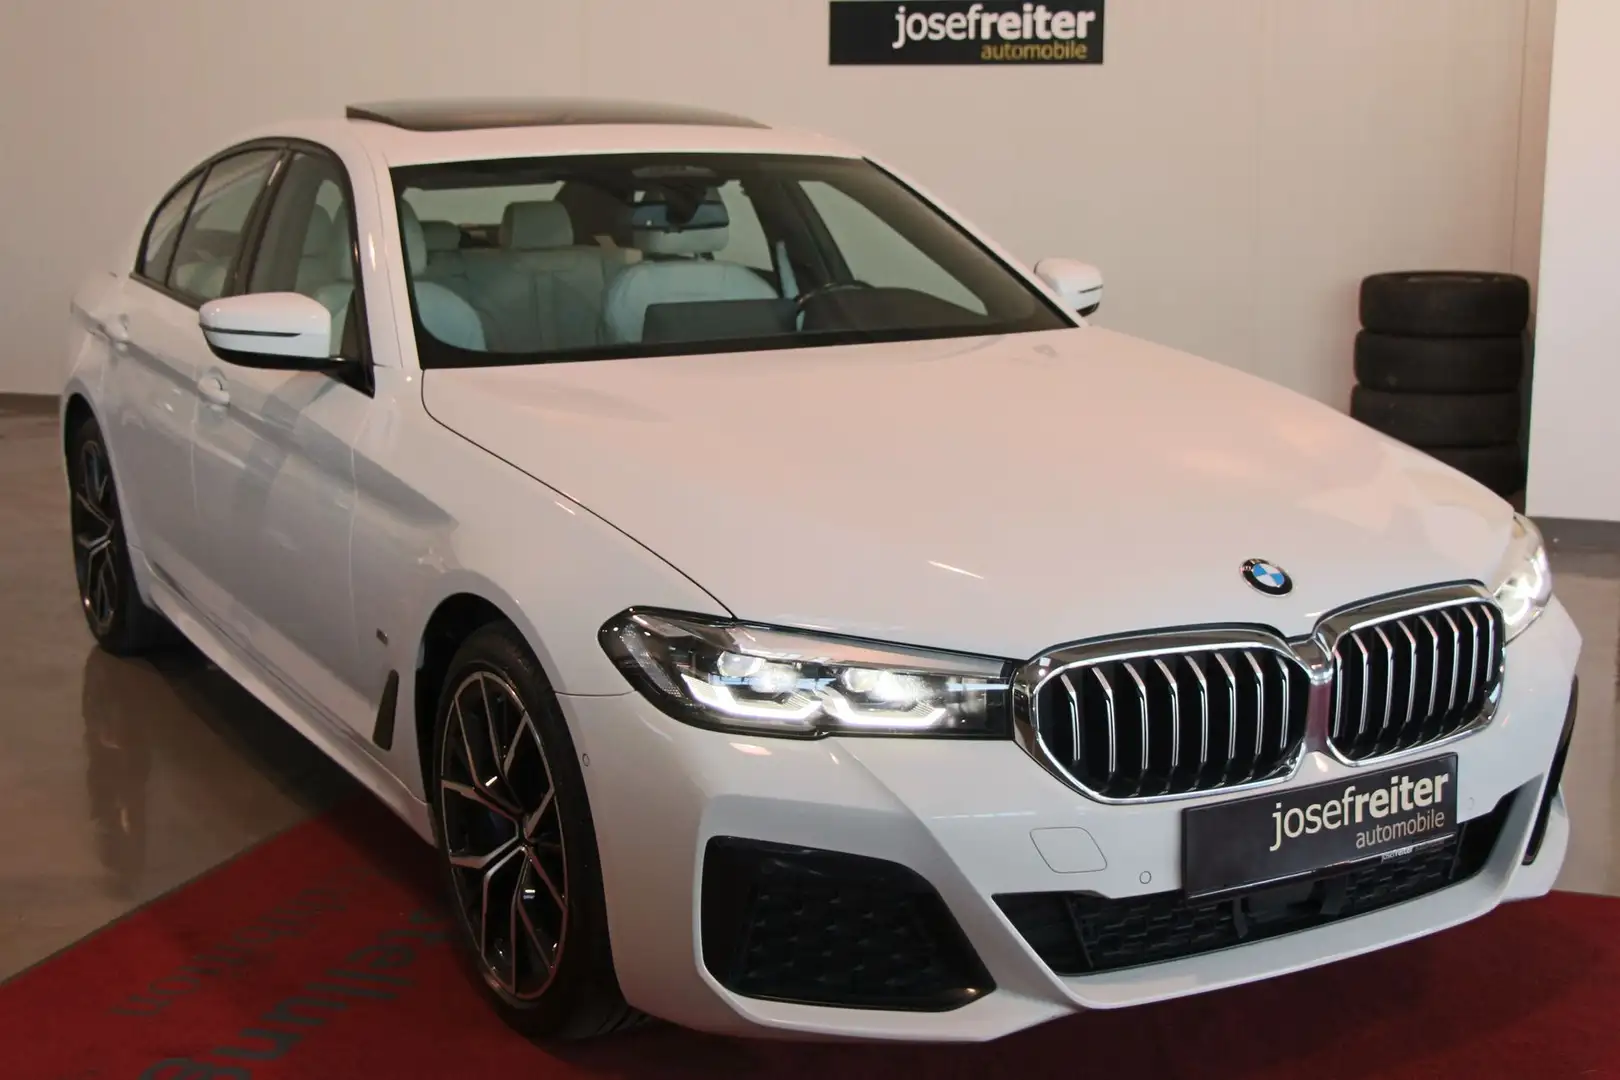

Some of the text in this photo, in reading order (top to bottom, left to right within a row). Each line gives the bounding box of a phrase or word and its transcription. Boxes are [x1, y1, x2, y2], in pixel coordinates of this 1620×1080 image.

[892, 3, 1096, 49] josefreiter
[981, 41, 1088, 60] automobile
[1269, 773, 1449, 851] josefreiter
[1355, 809, 1446, 849] automobile
